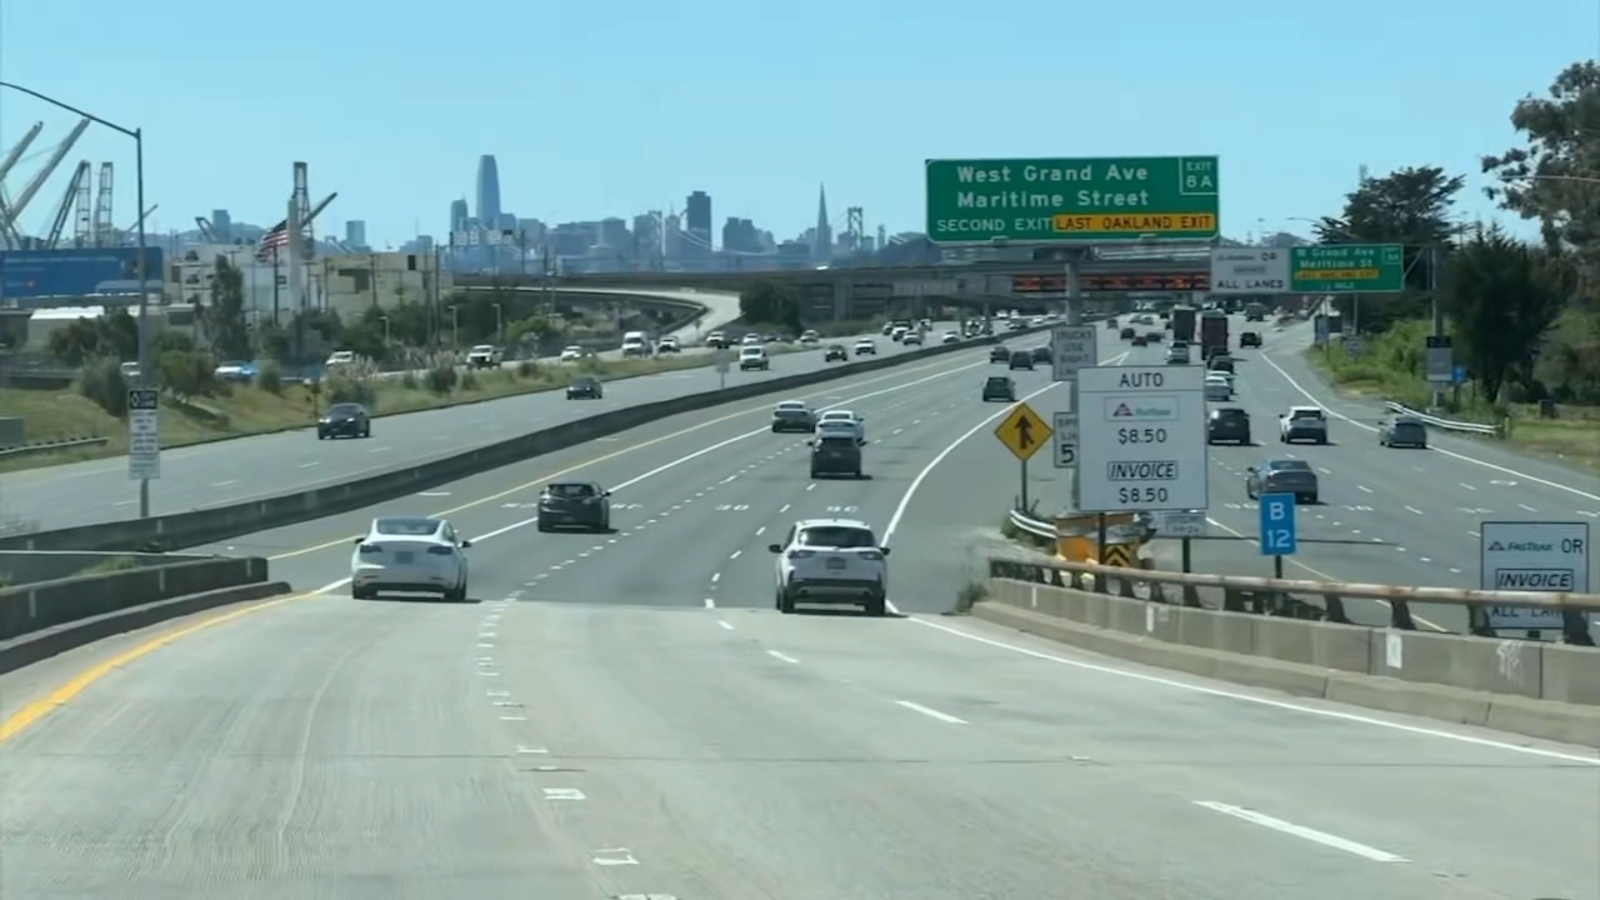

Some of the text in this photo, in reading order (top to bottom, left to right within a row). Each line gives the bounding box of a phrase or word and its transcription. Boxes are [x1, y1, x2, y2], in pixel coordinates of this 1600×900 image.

[957, 164, 1148, 182] West Grand Ave
[1186, 162, 1212, 171] EXIT
[957, 189, 1149, 208] Maritime Street
[937, 216, 1211, 232] SECOND EXIT LAST OAKLAND EXIT
[1300, 259, 1355, 268] Maritime
[1217, 280, 1240, 289] ALL
[1246, 279, 1284, 289] LANES
[1119, 373, 1164, 387] AUTO
[1118, 428, 1167, 445] $8.50
[1061, 444, 1075, 463] 5
[1110, 463, 1174, 478] INVOICE
[1119, 487, 1168, 504] $8.50
[1270, 502, 1285, 520] B
[1267, 529, 1291, 548] 12
[1561, 538, 1583, 554] OR
[1499, 573, 1571, 588] INVOICE
